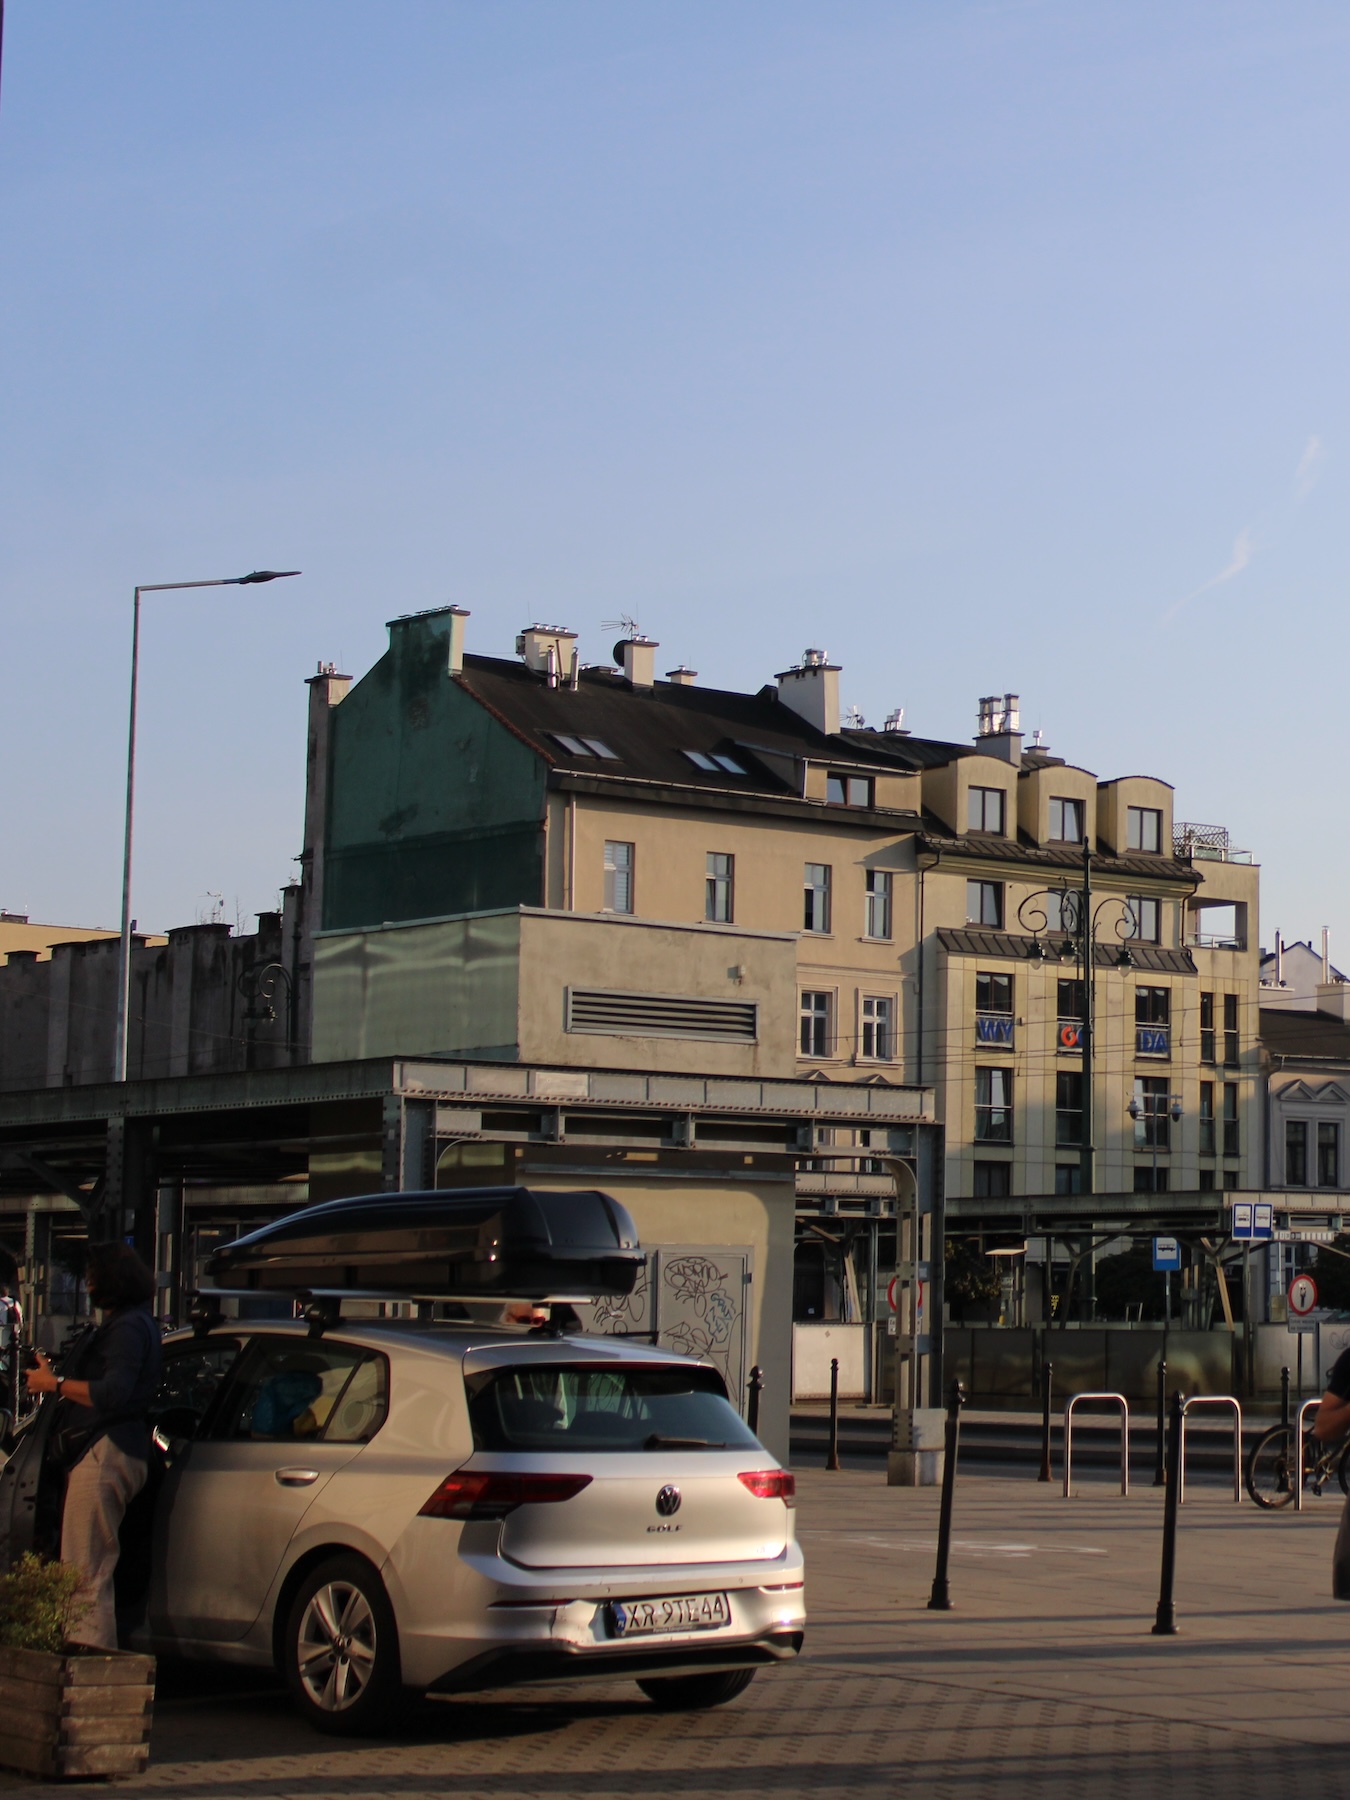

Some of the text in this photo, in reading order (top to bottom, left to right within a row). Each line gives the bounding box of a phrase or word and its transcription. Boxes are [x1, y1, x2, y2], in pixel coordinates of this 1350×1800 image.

[977, 1019, 1014, 1042] WY
[1140, 1030, 1169, 1053] DA
[646, 1524, 683, 1534] GOLF
